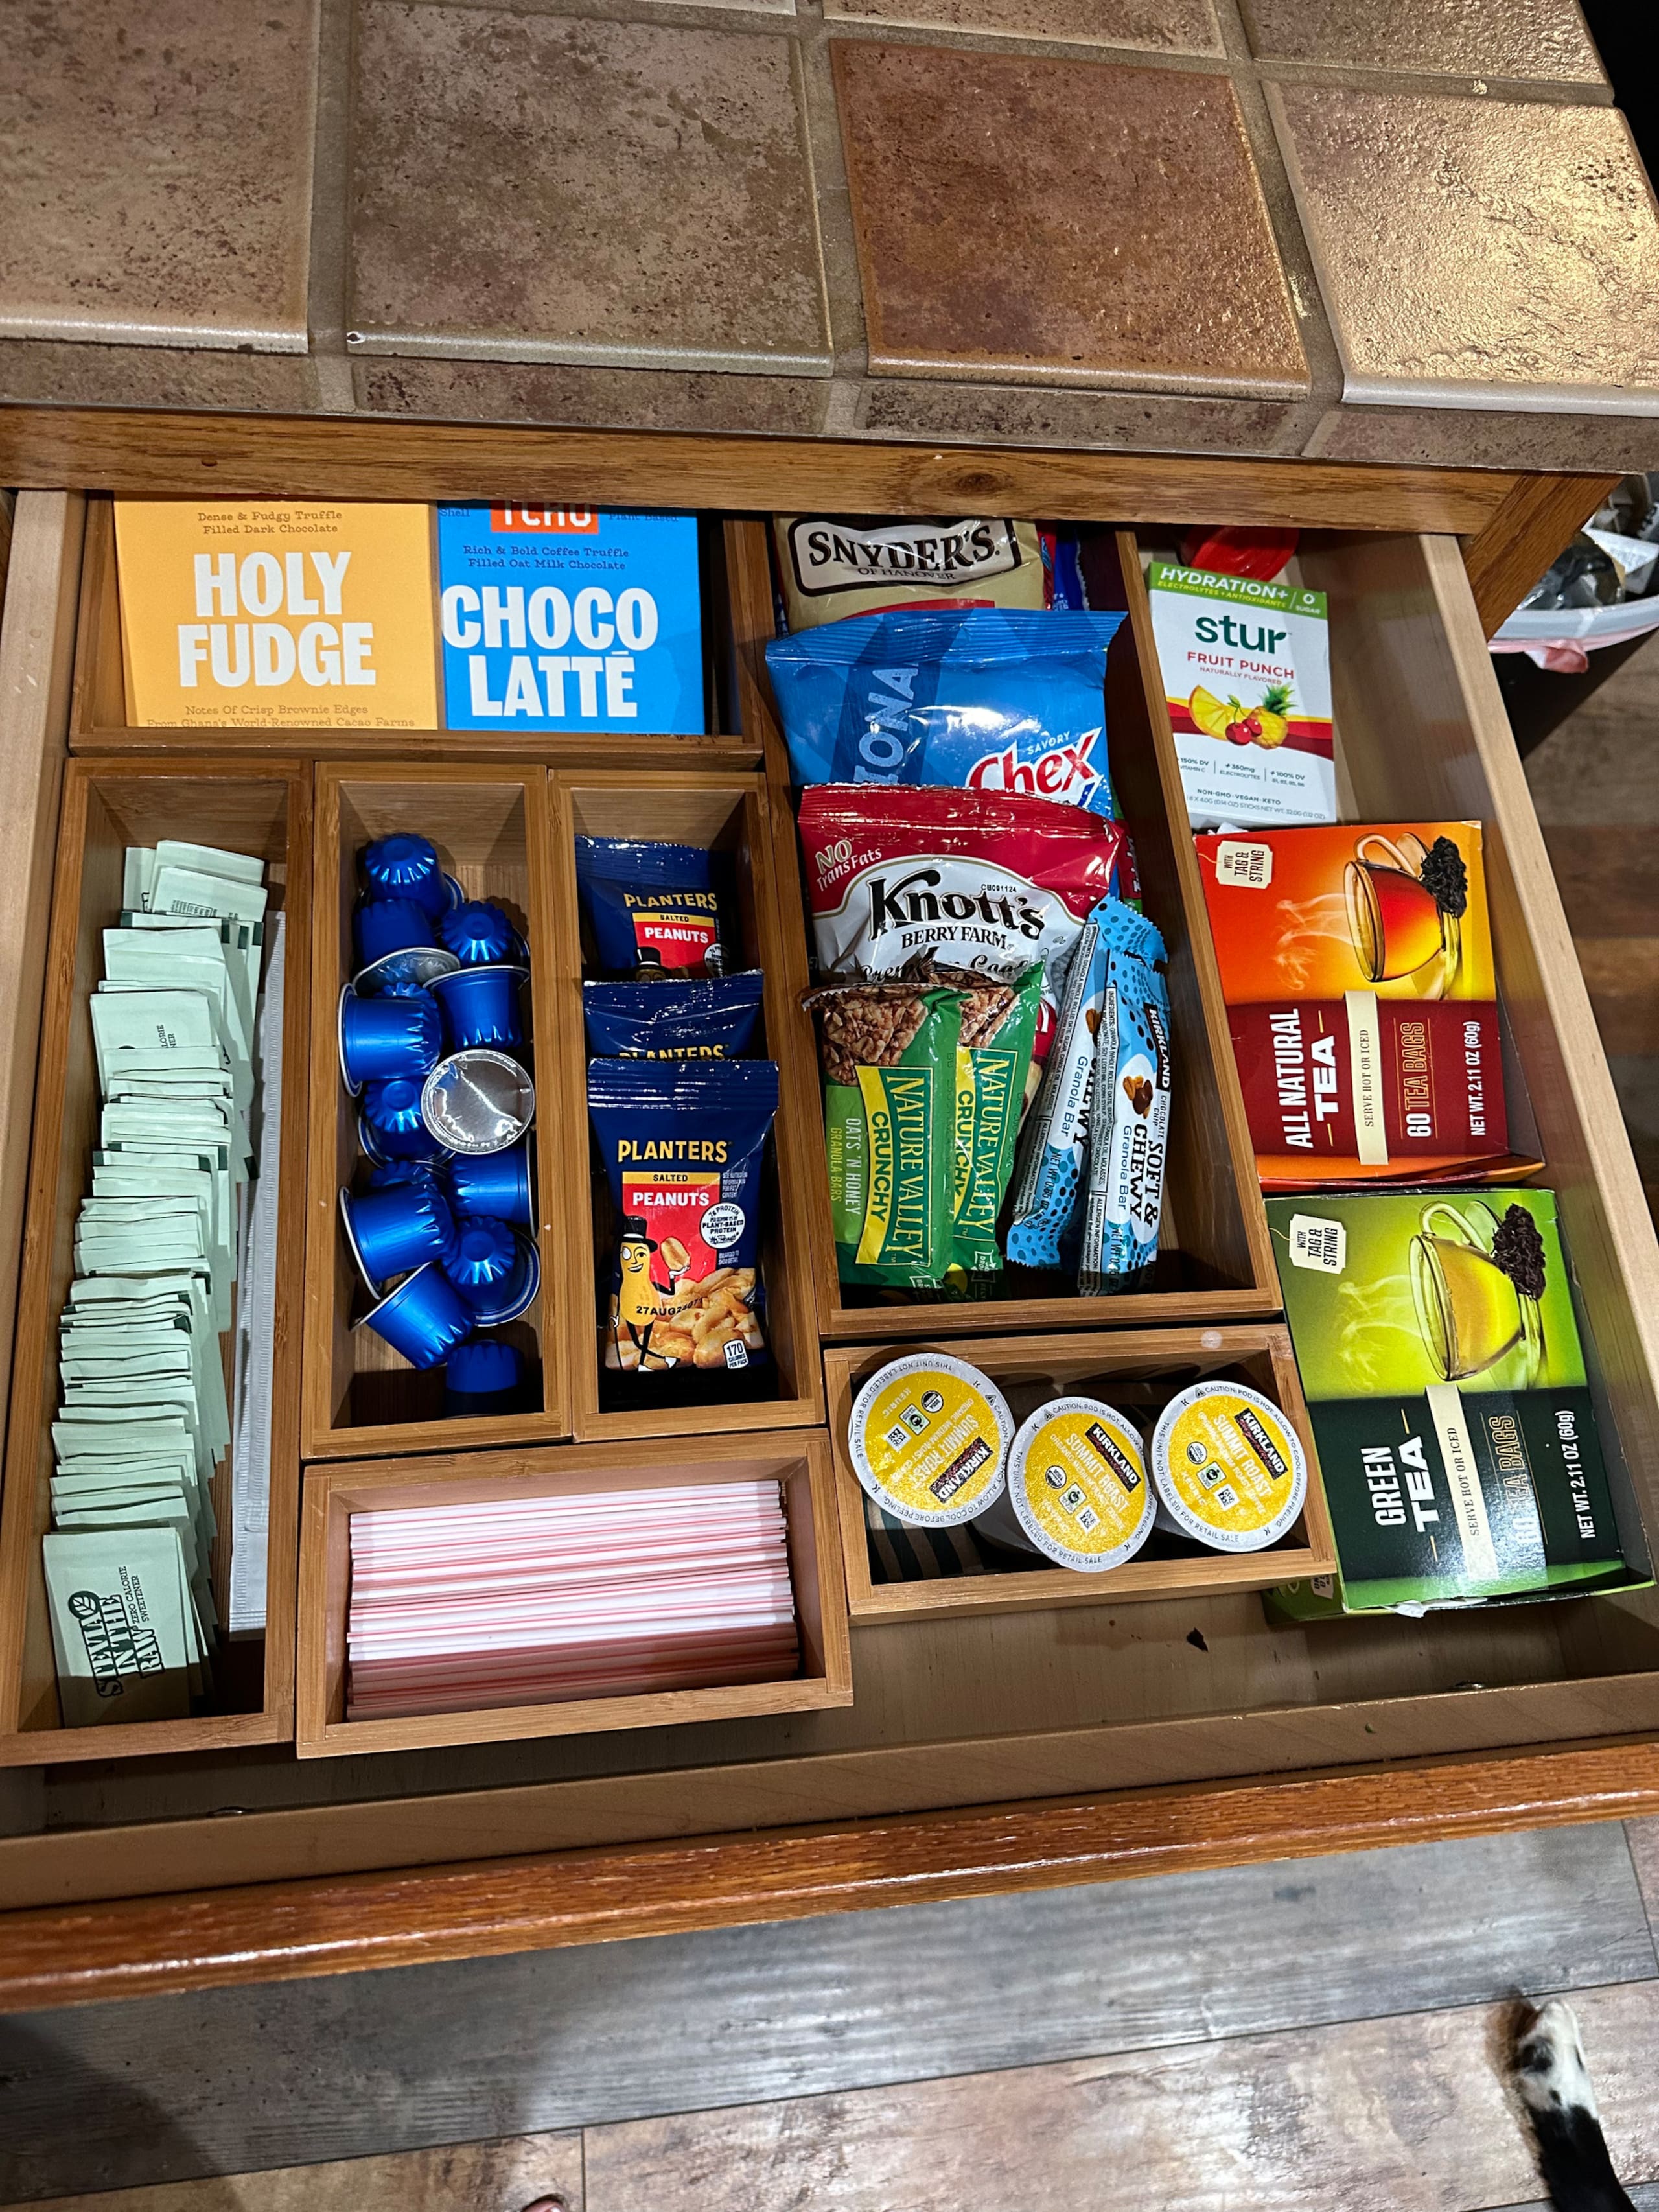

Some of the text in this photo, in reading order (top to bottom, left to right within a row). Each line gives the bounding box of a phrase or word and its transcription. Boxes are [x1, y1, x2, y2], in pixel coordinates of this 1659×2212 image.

[198, 510, 342, 523] Dense & Fudgy Truffle
[203, 523, 338, 535] Filled Dark Chocolate
[439, 508, 470, 517] Shell
[463, 546, 629, 557] Rich & Bold Coffee Truffle
[468, 559, 625, 570] Filled Oat Milk Chocolate
[807, 525, 995, 572] SNYDER'S
[194, 552, 351, 616] HOLY
[858, 567, 955, 581] OF HANOVER
[1157, 581, 1286, 607] ELECTROLYTES ANTIOXIDANTS
[1161, 567, 1288, 599] HYDRATION+
[441, 585, 658, 651] CHOCO
[1296, 605, 1321, 614] SUGAR
[1302, 594, 1315, 604] 0
[178, 622, 376, 687] FUDGE
[1195, 616, 1287, 654] stur
[469, 651, 637, 718] LATTÉ
[1187, 651, 1294, 679] FRUIT PUNCH
[1200, 667, 1282, 684] NATURALLY FLAVORED
[147, 718, 415, 728] From Ghana's World-Renowned Cacao Farms
[185, 704, 368, 716] Notes Of Crisp Brownie Edges
[969, 733, 1096, 794] Chex
[1027, 731, 1071, 755] SAVORY
[815, 839, 853, 875] NO
[816, 847, 883, 892] Trans Fats
[1224, 855, 1233, 869] WITH
[1235, 861, 1249, 877] TAG
[1249, 850, 1265, 883] STRING
[624, 892, 717, 911] PLANTERS
[866, 868, 1045, 941] Knott's
[645, 927, 708, 943] PEANUTS
[902, 926, 1007, 950] BERRY FARM
[1148, 1008, 1170, 1089] KIRKLAND
[1060, 1056, 1088, 1137] Granola Bar
[1270, 1008, 1314, 1148] ALL NATURAL
[1311, 1035, 1339, 1121] TEA
[1360, 1030, 1373, 1127] SERVE HOT OR ICED
[1400, 1022, 1432, 1137] 60 TEA BAGS
[1463, 1021, 1485, 1135] NET WT. 2.11 OZ (60g)
[975, 1057, 1008, 1145] NATURE
[1157, 1095, 1166, 1139] CHOCOLATE
[618, 1139, 728, 1163] PLANTERS
[846, 1117, 861, 1151] OATS
[830, 1127, 843, 1202] GRANOLA BARS
[869, 1110, 892, 1222] CRUNCHY
[885, 1075, 925, 1266] NATURE VALLEY
[1045, 1150, 1062, 1180] NET WT
[1117, 1126, 1131, 1210] Granola Bar
[1130, 1124, 1147, 1221] CHEWY
[1144, 1140, 1163, 1228] SOFT &
[632, 1192, 709, 1206] PEANUTS
[716, 1205, 740, 1215] PROTEIN
[846, 1171, 861, 1215] HONEY
[958, 1148, 1000, 1235] VALLEY
[702, 1220, 743, 1228] PLANT-BASED
[1297, 1231, 1306, 1248] WITH
[1308, 1229, 1322, 1258] TAG &
[1323, 1228, 1338, 1266] STRING
[726, 1343, 743, 1356] 170
[939, 1414, 979, 1457] SUMMIT
[1161, 1421, 1170, 1438] THIS
[1238, 1389, 1252, 1398] POD
[1274, 1414, 1292, 1438] ALLOW
[1289, 1437, 1297, 1448] TO
[1066, 1433, 1104, 1478] SUMMIT
[1093, 1427, 1137, 1484] KIRKLAND
[1214, 1414, 1274, 1497] SUMMIT ROAST
[1243, 1412, 1284, 1473] KIRKLAND
[1489, 1416, 1525, 1471] BAGS
[939, 1447, 990, 1500] KIRKLAND
[1157, 1460, 1166, 1476] NOT
[1362, 1446, 1407, 1526] GREEN
[1398, 1436, 1441, 1533] TEA
[1447, 1428, 1481, 1537] SERVE HOT OR ICED
[1555, 1411, 1595, 1537] NET WT. 2.11 OZ (60g)
[1161, 1476, 1180, 1511] LABELED
[1180, 1511, 1194, 1526] FOR
[1194, 1524, 1219, 1539] RETAIL
[1221, 1533, 1239, 1542] SALE
[119, 1566, 139, 1624] ZERO CALORIE
[132, 1574, 150, 1622] SWEETENER
[79, 1611, 124, 1697] STEVIA
